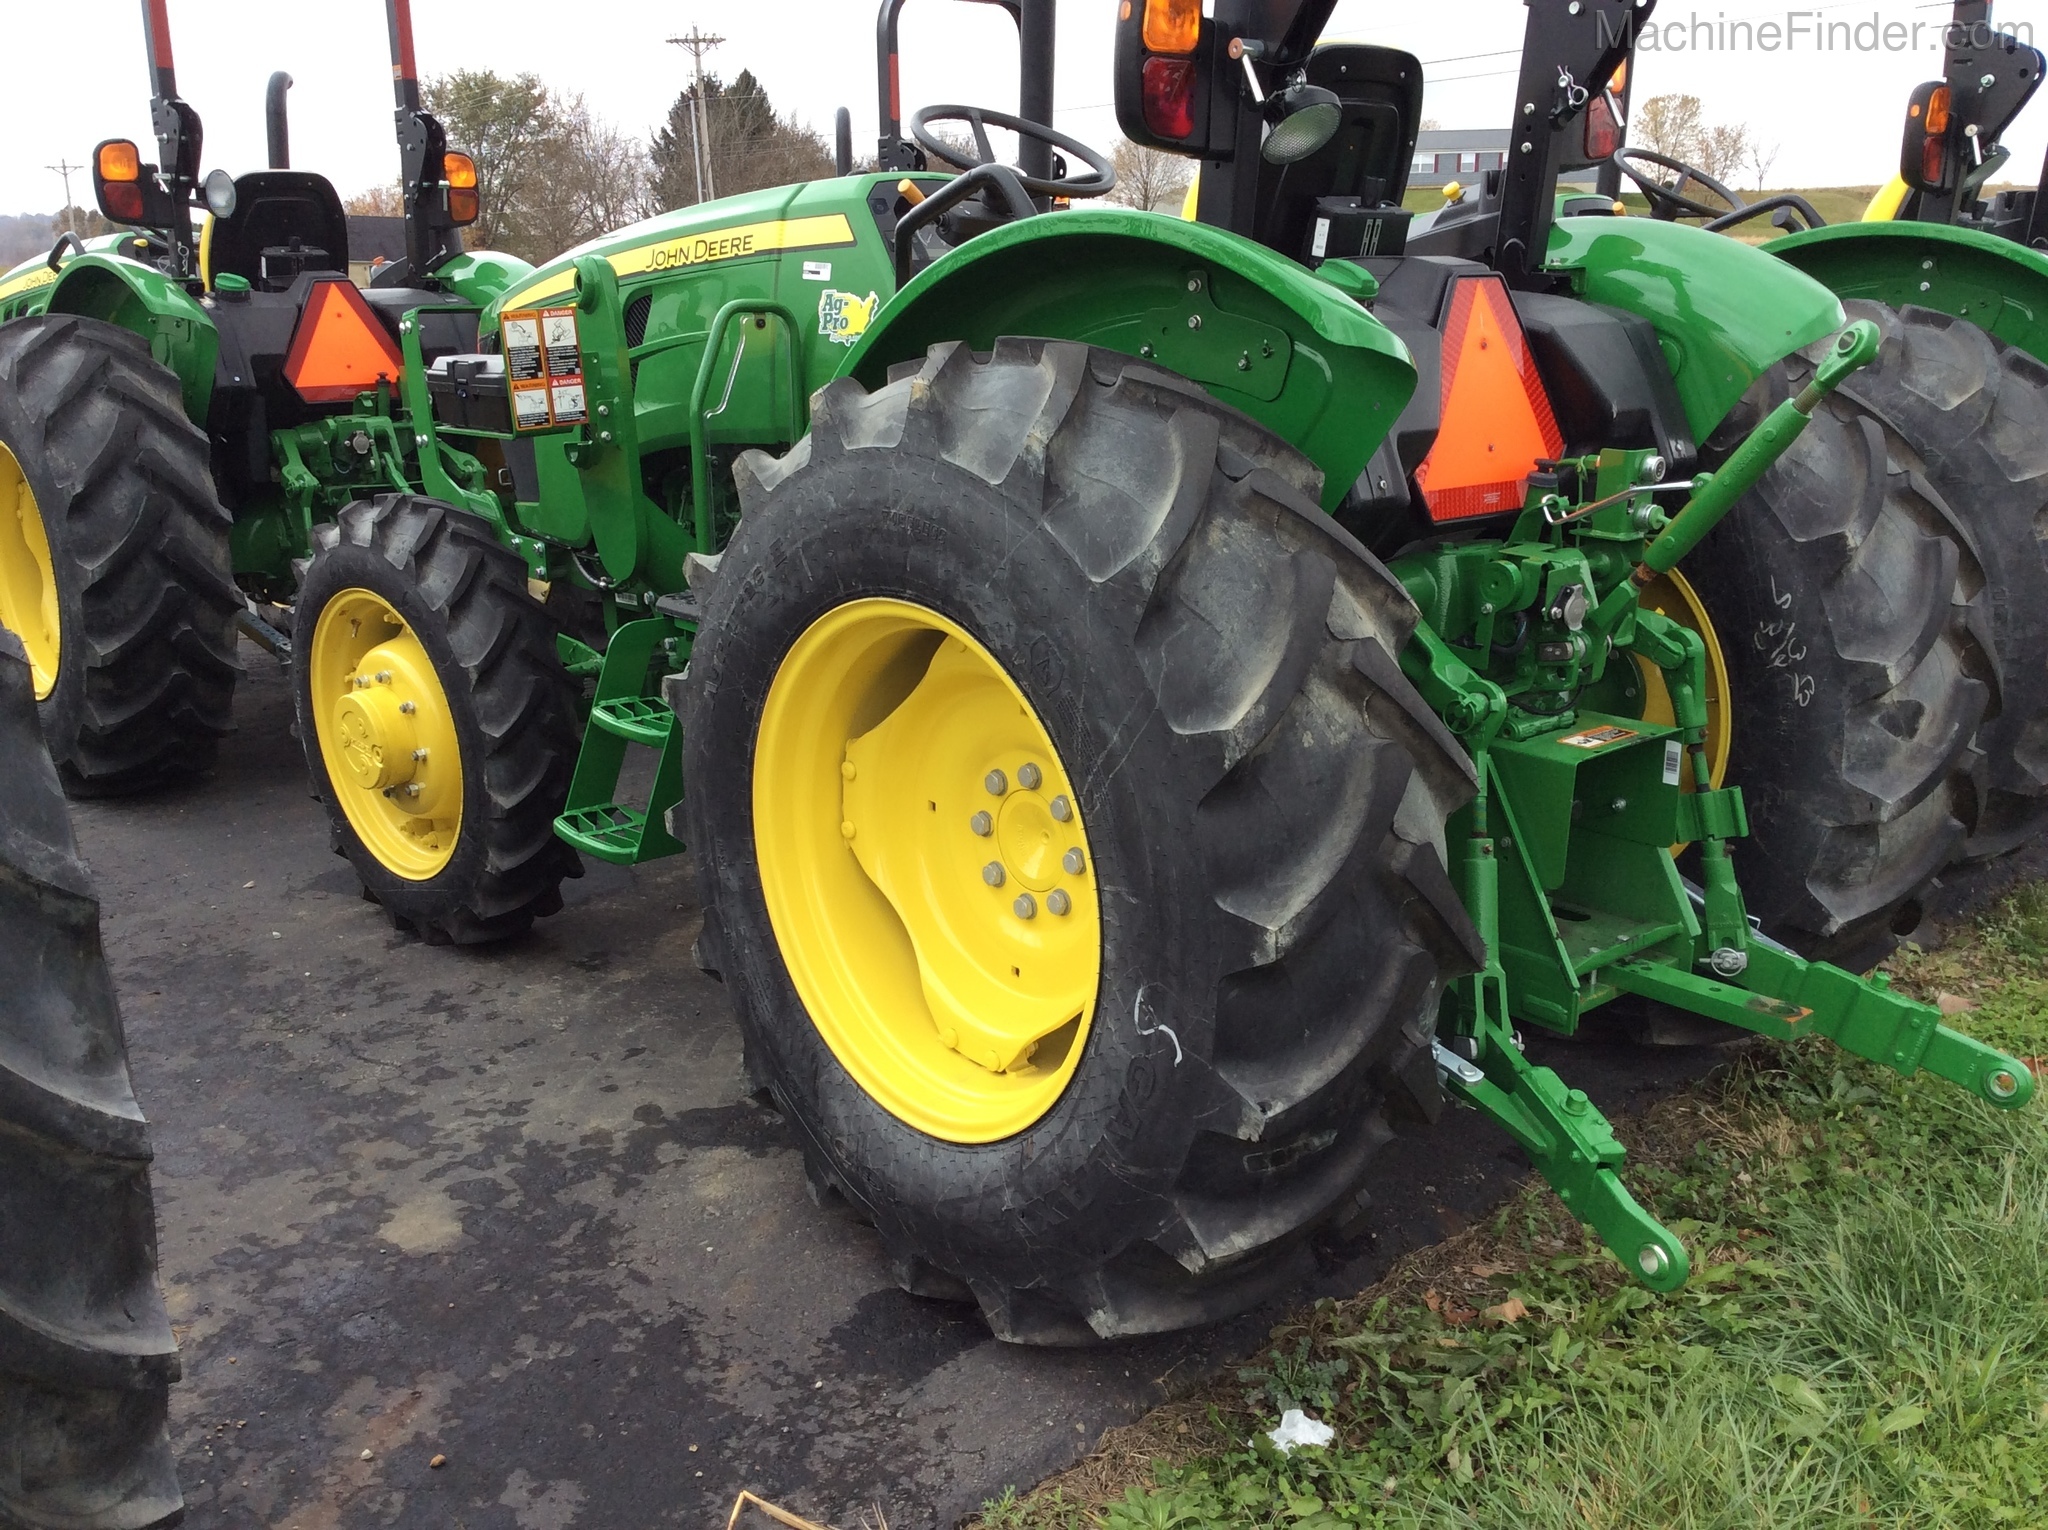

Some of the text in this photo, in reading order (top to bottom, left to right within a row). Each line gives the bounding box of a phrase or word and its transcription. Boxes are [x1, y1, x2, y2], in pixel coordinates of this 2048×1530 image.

[646, 235, 753, 268] JOHN DEERE
[550, 309, 573, 317] DANGER
[822, 294, 849, 315] Ag-
[822, 313, 849, 330] Pro
[559, 378, 581, 386] DANGER
